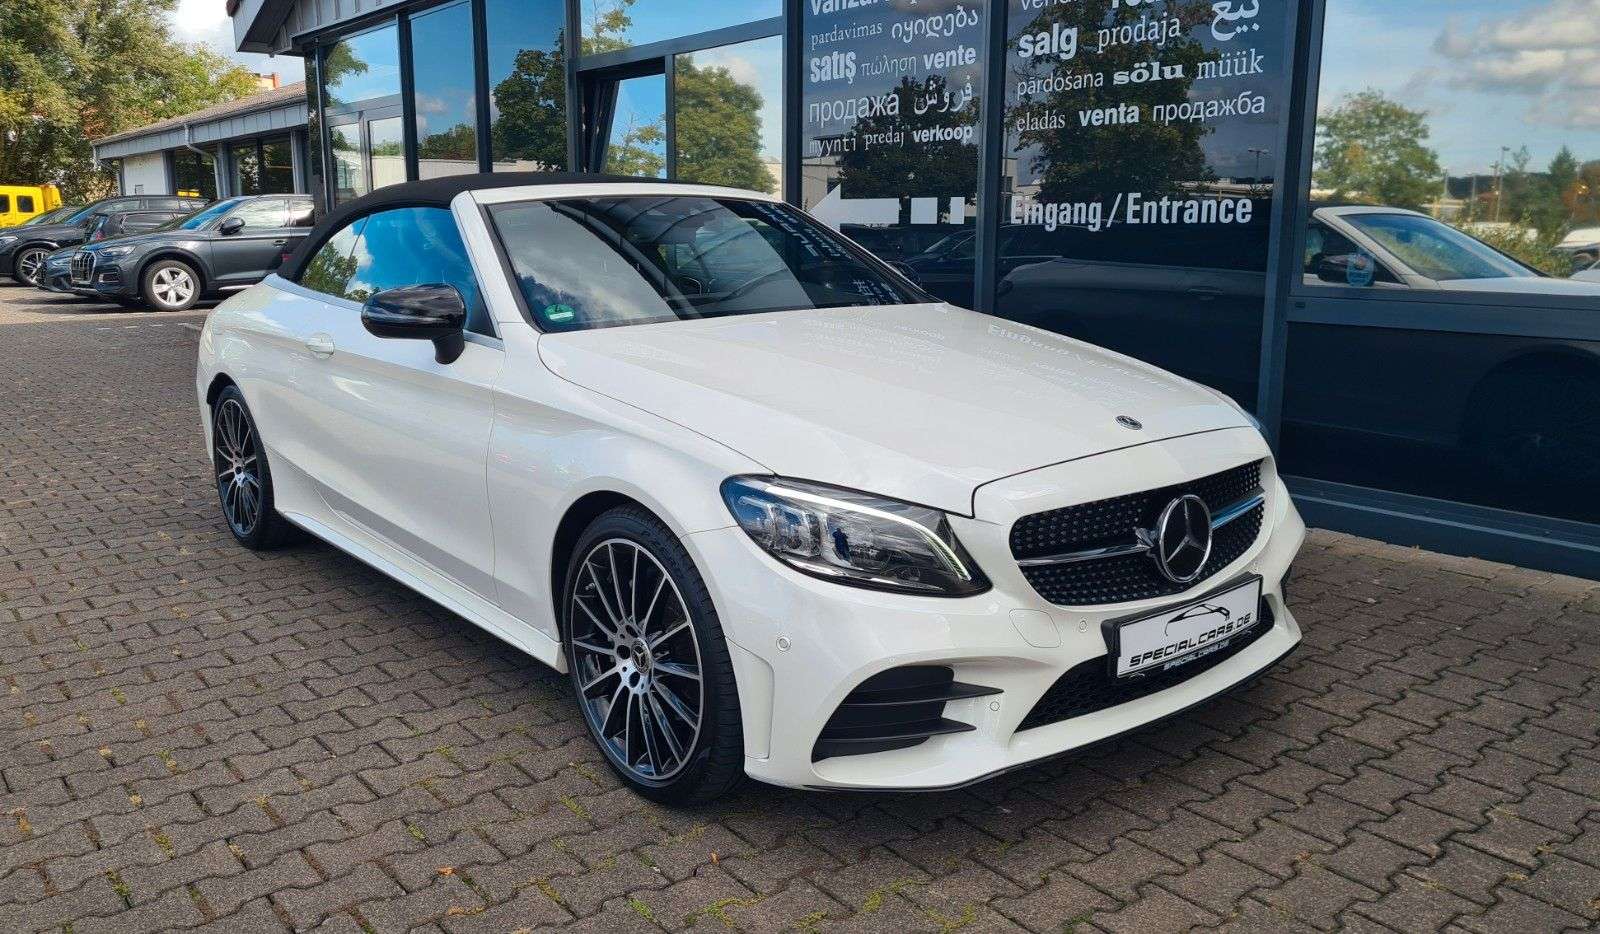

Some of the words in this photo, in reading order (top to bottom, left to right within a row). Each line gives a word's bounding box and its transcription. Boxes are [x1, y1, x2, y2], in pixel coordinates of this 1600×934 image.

[811, 22, 883, 50] pardavimas
[891, 5, 979, 43] იყიდება
[1096, 12, 1182, 54] prodaja
[923, 45, 976, 70] vente
[1018, 23, 1078, 60] salg
[810, 50, 857, 84] satış
[1112, 61, 1186, 85] sölu
[1196, 48, 1265, 80] müük
[809, 93, 900, 128] продажа
[914, 75, 973, 115] فروش
[1153, 91, 1266, 126] продажба
[1016, 110, 1066, 132] eladás
[1079, 102, 1140, 127] venta
[809, 130, 857, 157] myynti
[864, 126, 905, 150] predaj
[912, 124, 974, 145] verkoop
[1010, 195, 1102, 232] Eingang
[1126, 192, 1253, 224] Entrance
